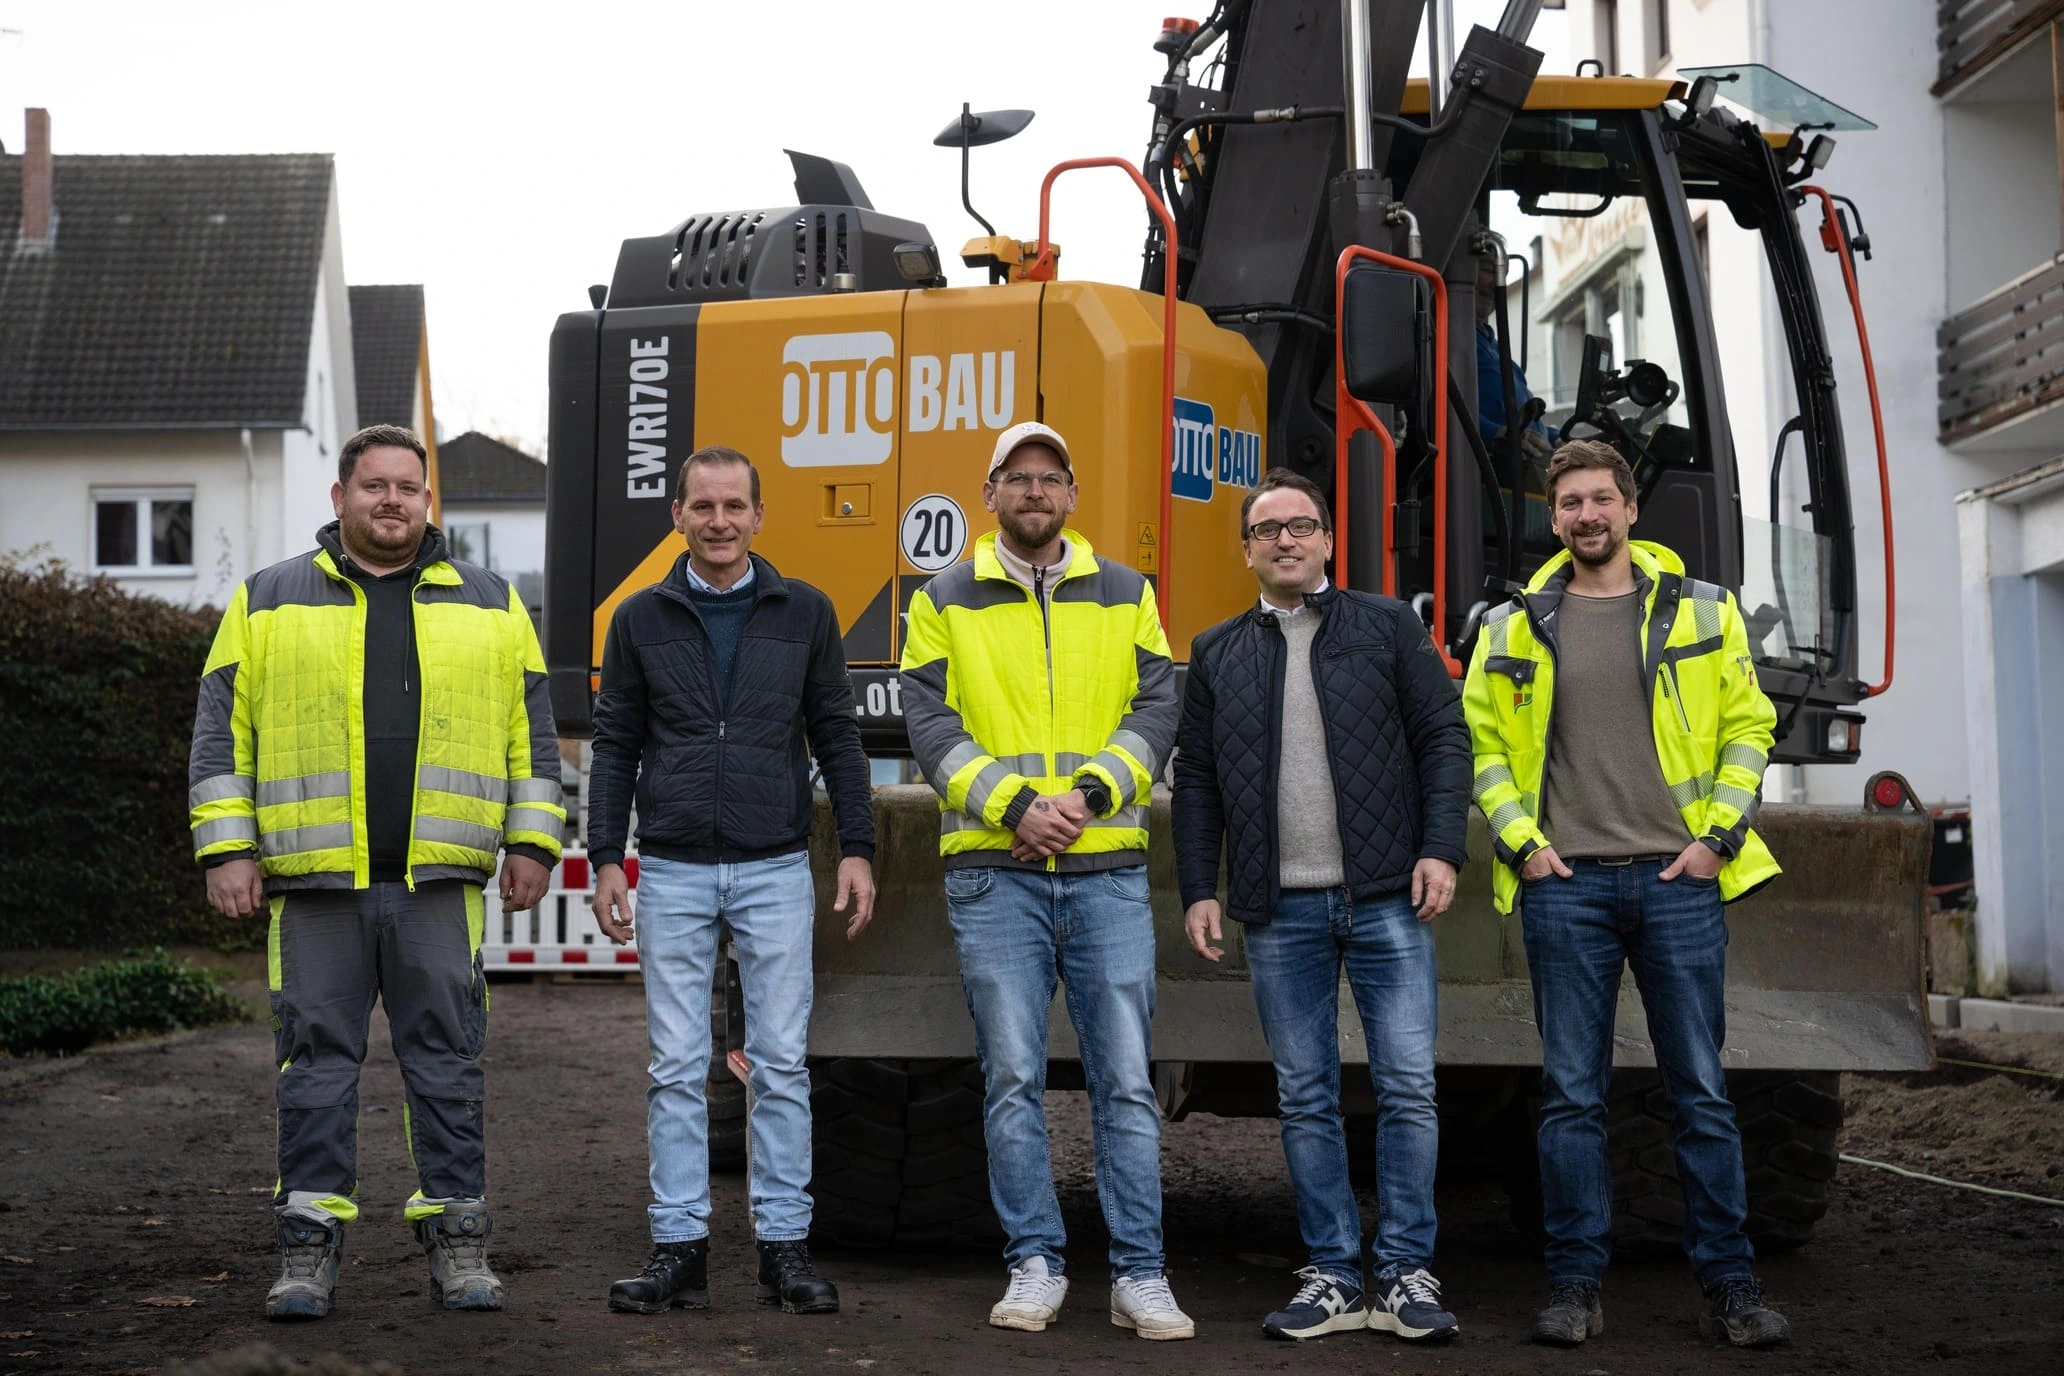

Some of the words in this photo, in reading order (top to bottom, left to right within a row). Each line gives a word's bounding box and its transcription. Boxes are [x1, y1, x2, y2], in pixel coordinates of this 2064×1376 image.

[627, 335, 669, 499] EWR170E
[782, 355, 895, 438] OTTO
[908, 350, 1016, 433] BAU
[1217, 424, 1261, 489] BAU
[912, 508, 954, 558] 20
